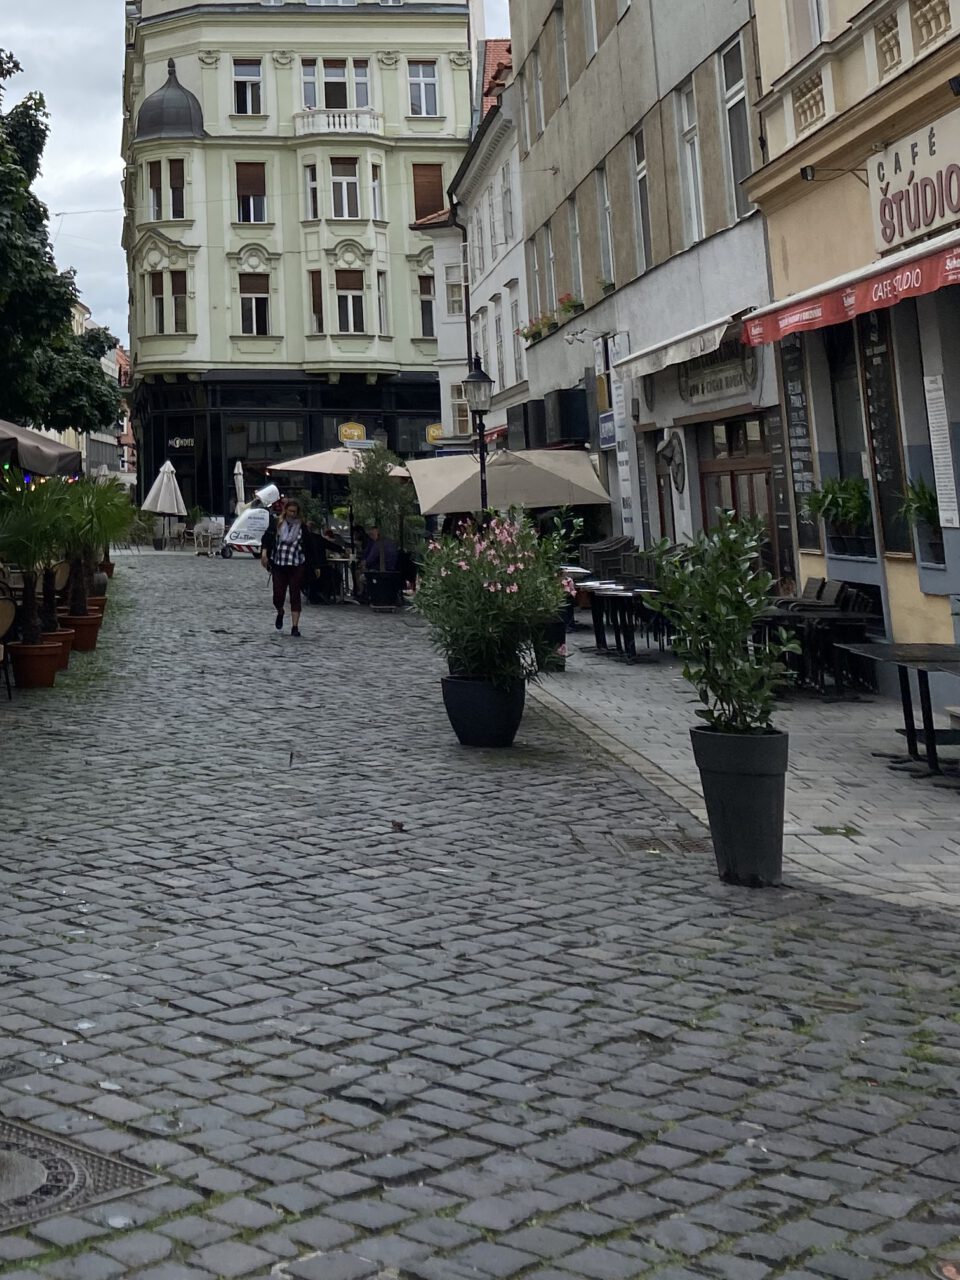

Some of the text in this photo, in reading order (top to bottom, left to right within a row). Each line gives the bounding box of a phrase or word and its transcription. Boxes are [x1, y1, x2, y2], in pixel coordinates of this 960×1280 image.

[877, 127, 936, 182] CAFÉ
[879, 163, 960, 243] ŠTÚDIO
[872, 280, 892, 302] CAFE
